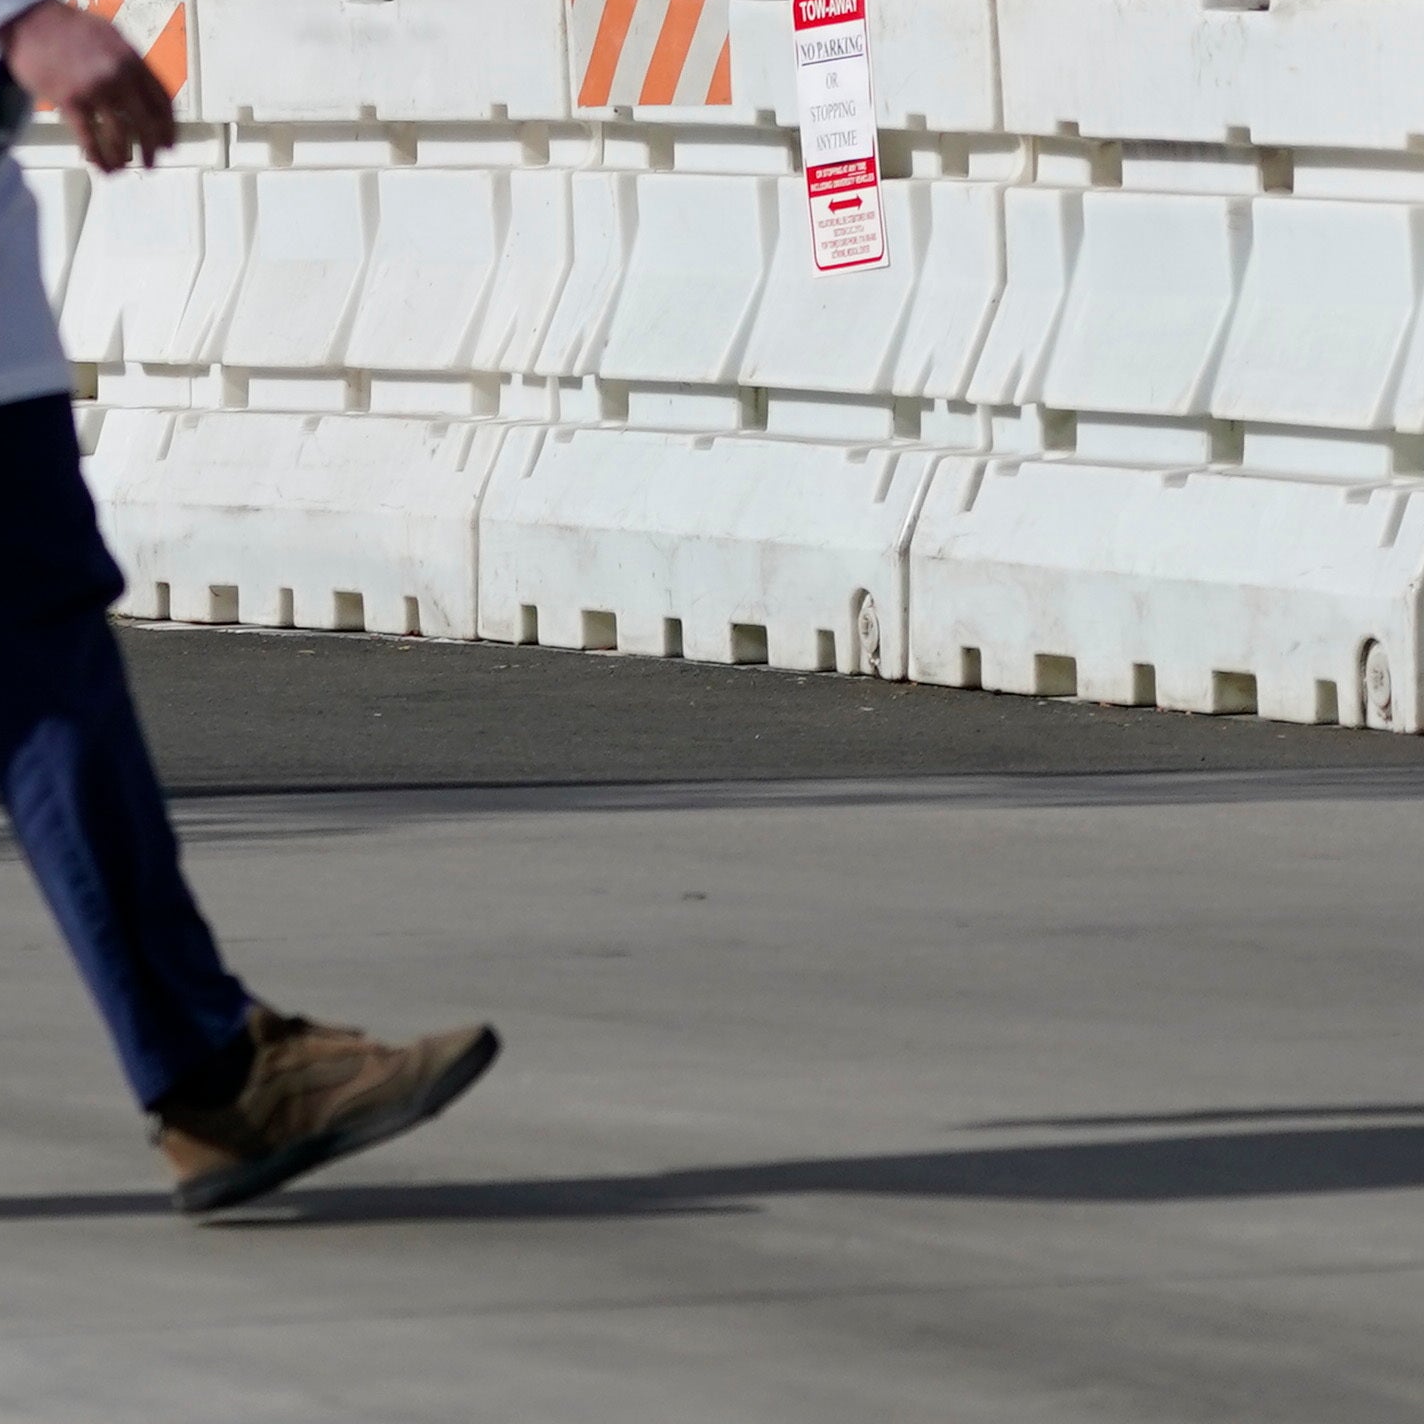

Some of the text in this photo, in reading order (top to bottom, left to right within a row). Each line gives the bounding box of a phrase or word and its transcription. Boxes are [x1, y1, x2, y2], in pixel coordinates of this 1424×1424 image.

[800, 34, 863, 61] NO PARKING
[826, 72, 839, 89] OR
[810, 100, 856, 122] STOPPING
[816, 129, 858, 151] ANYTIME
